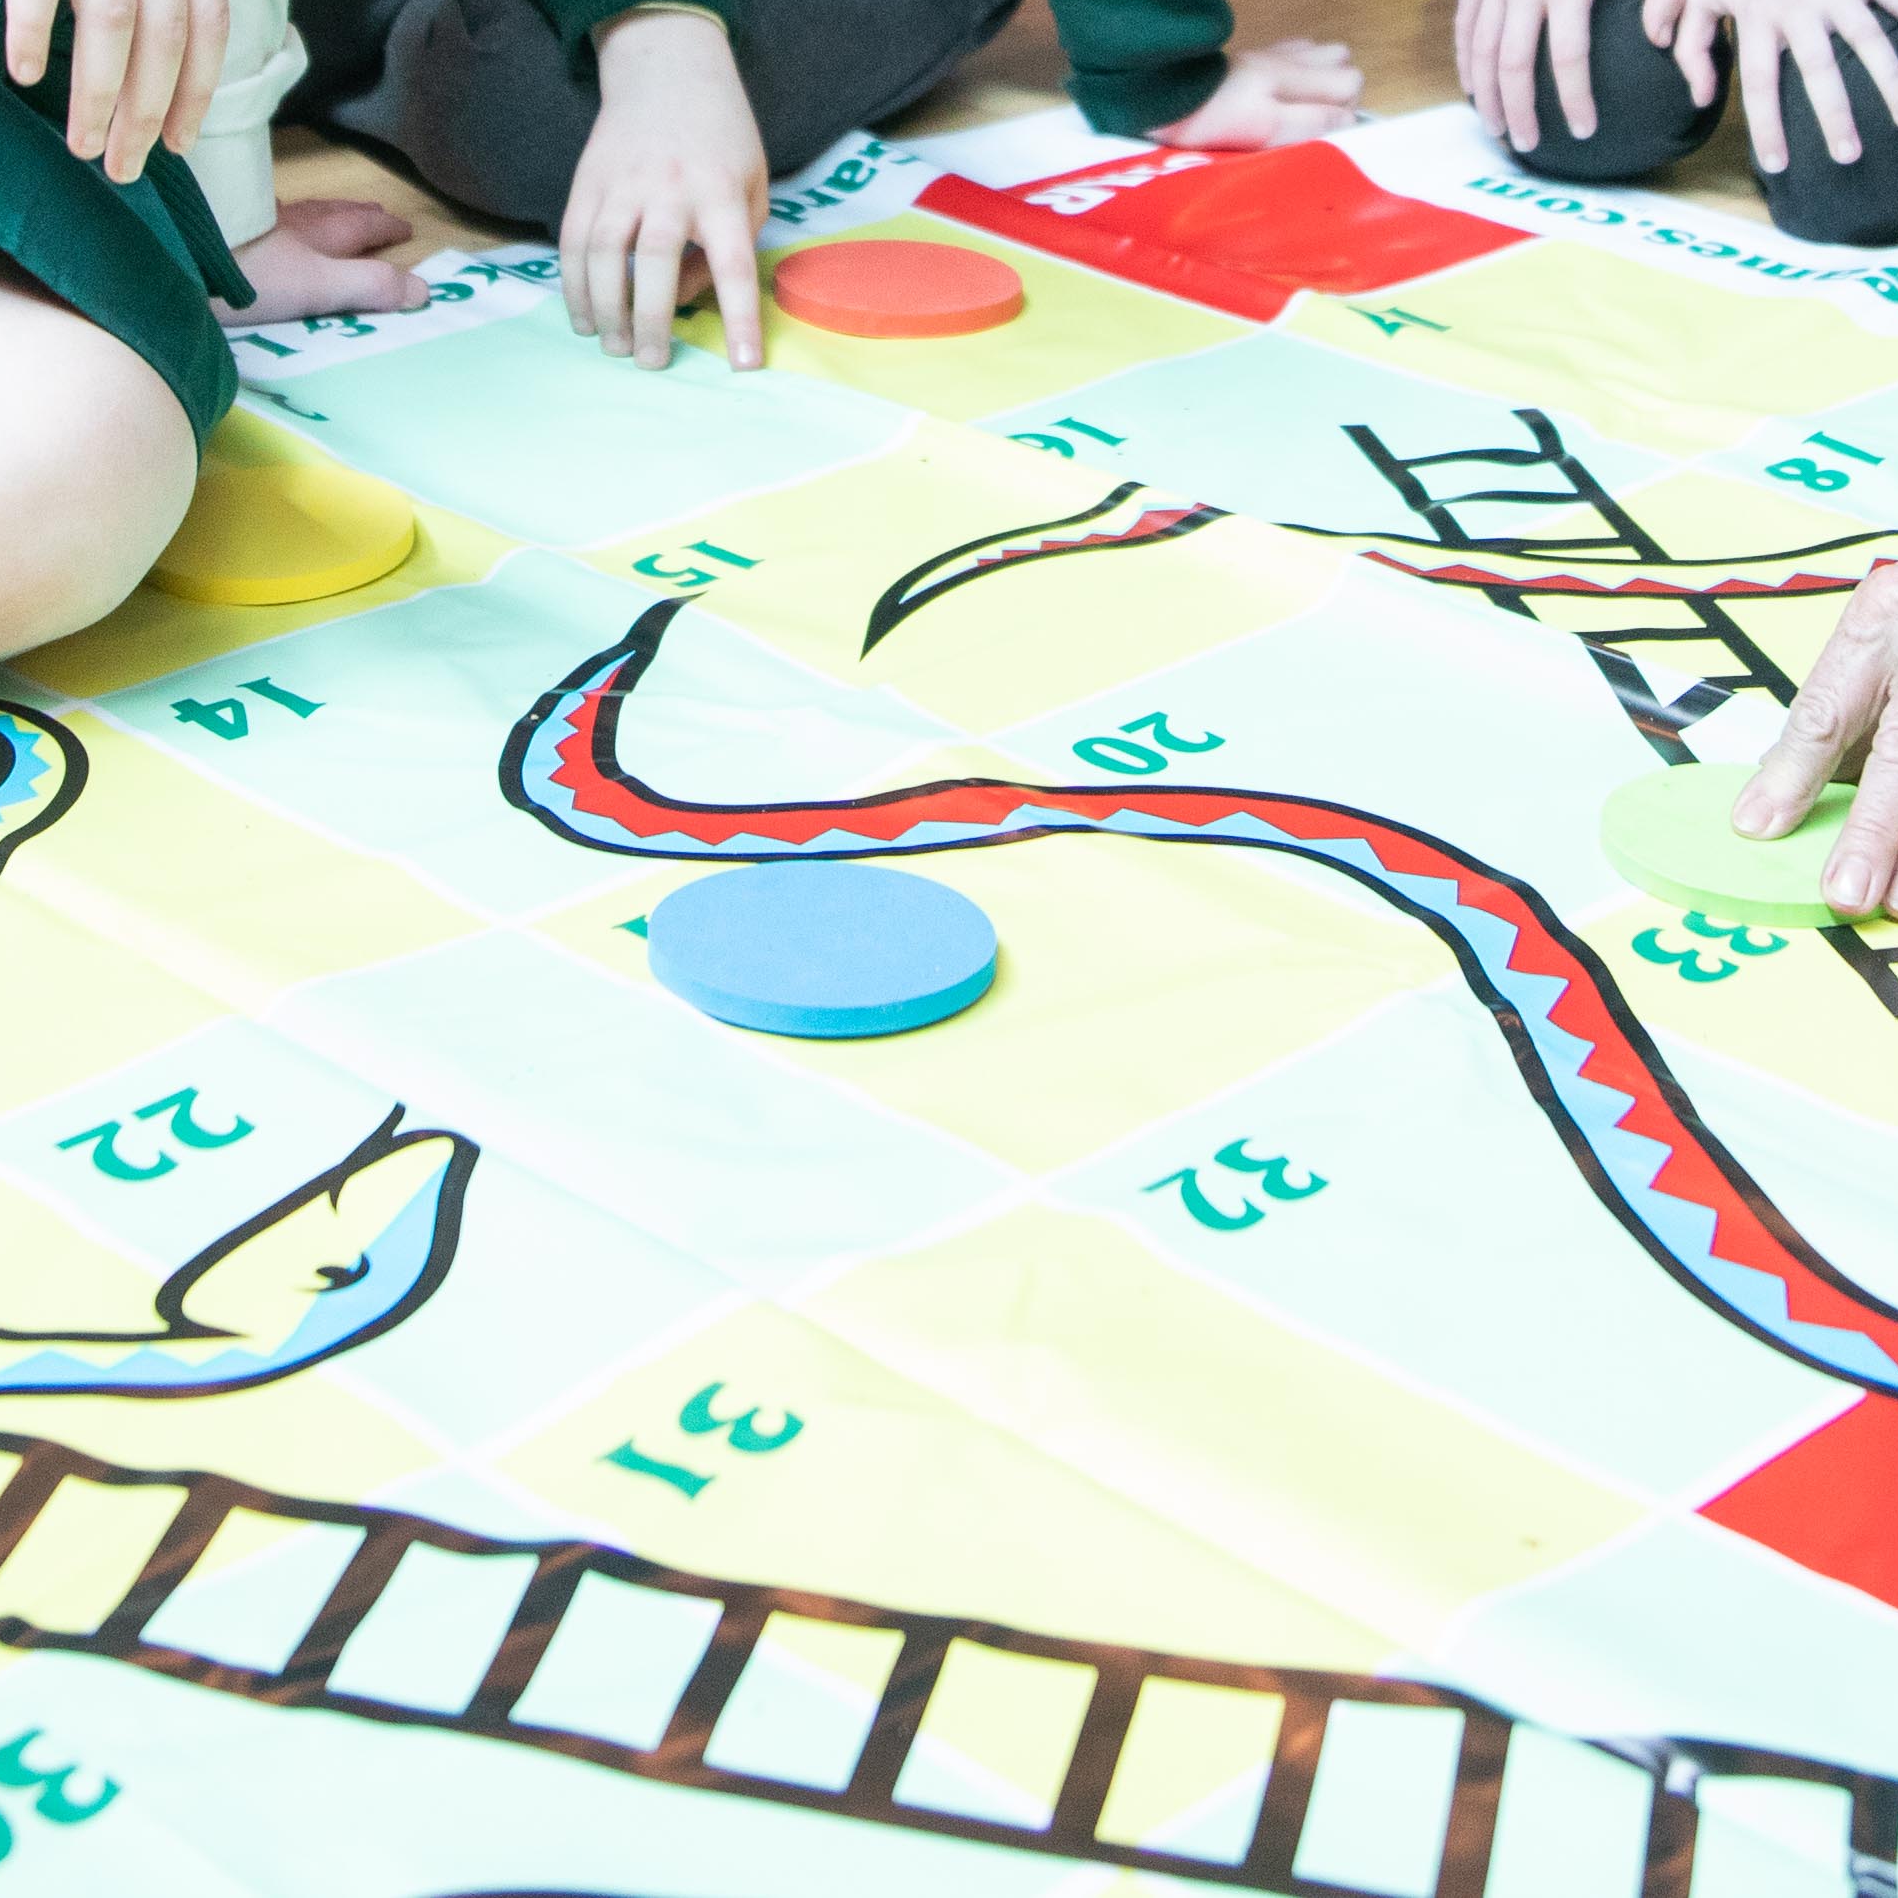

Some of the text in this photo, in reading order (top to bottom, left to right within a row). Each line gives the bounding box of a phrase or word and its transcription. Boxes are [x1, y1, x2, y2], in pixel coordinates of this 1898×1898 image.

[1765, 430, 1886, 493] 18
[631, 540, 762, 590] 15
[168, 675, 327, 741] 14
[1070, 711, 1227, 777] 20
[1631, 910, 1790, 984] 33
[56, 1086, 257, 1182] 22
[1142, 1138, 1330, 1233] 32
[596, 1381, 806, 1501] 31
